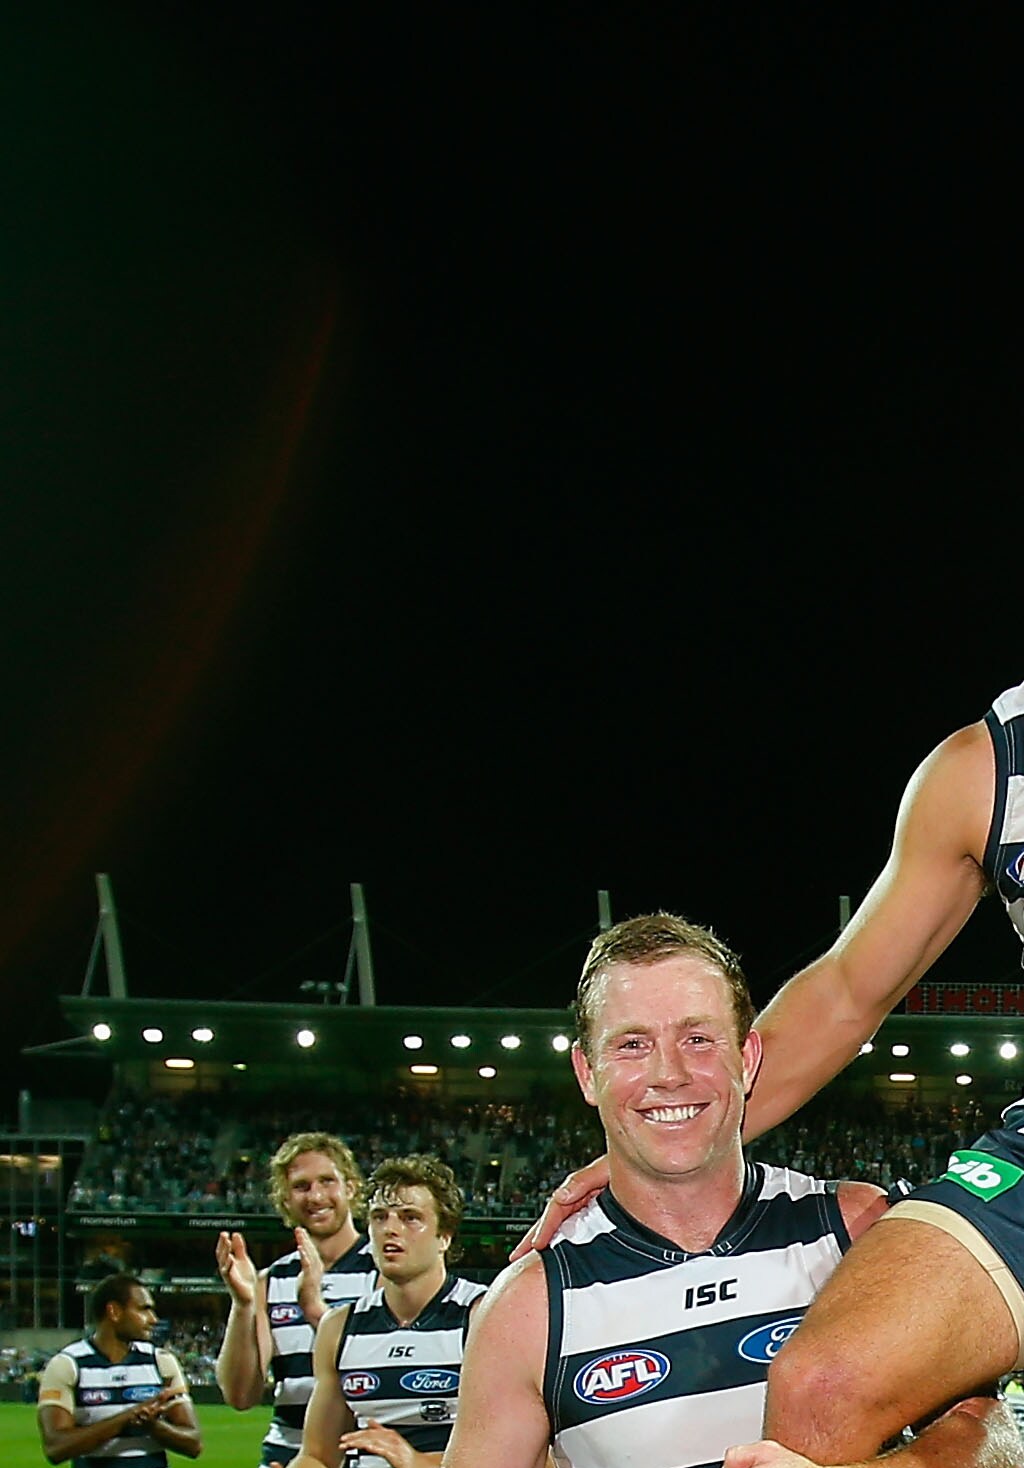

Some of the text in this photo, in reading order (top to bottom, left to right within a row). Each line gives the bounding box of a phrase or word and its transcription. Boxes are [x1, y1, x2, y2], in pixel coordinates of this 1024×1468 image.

[80, 1216, 136, 1225] momentum
[189, 1218, 245, 1227] momentum
[684, 1278, 738, 1310] ISC
[271, 1306, 298, 1320] AFL
[388, 1346, 416, 1358] ISC
[343, 1376, 375, 1391] AFL
[411, 1371, 452, 1389] Ford
[584, 1359, 662, 1397] AFL
